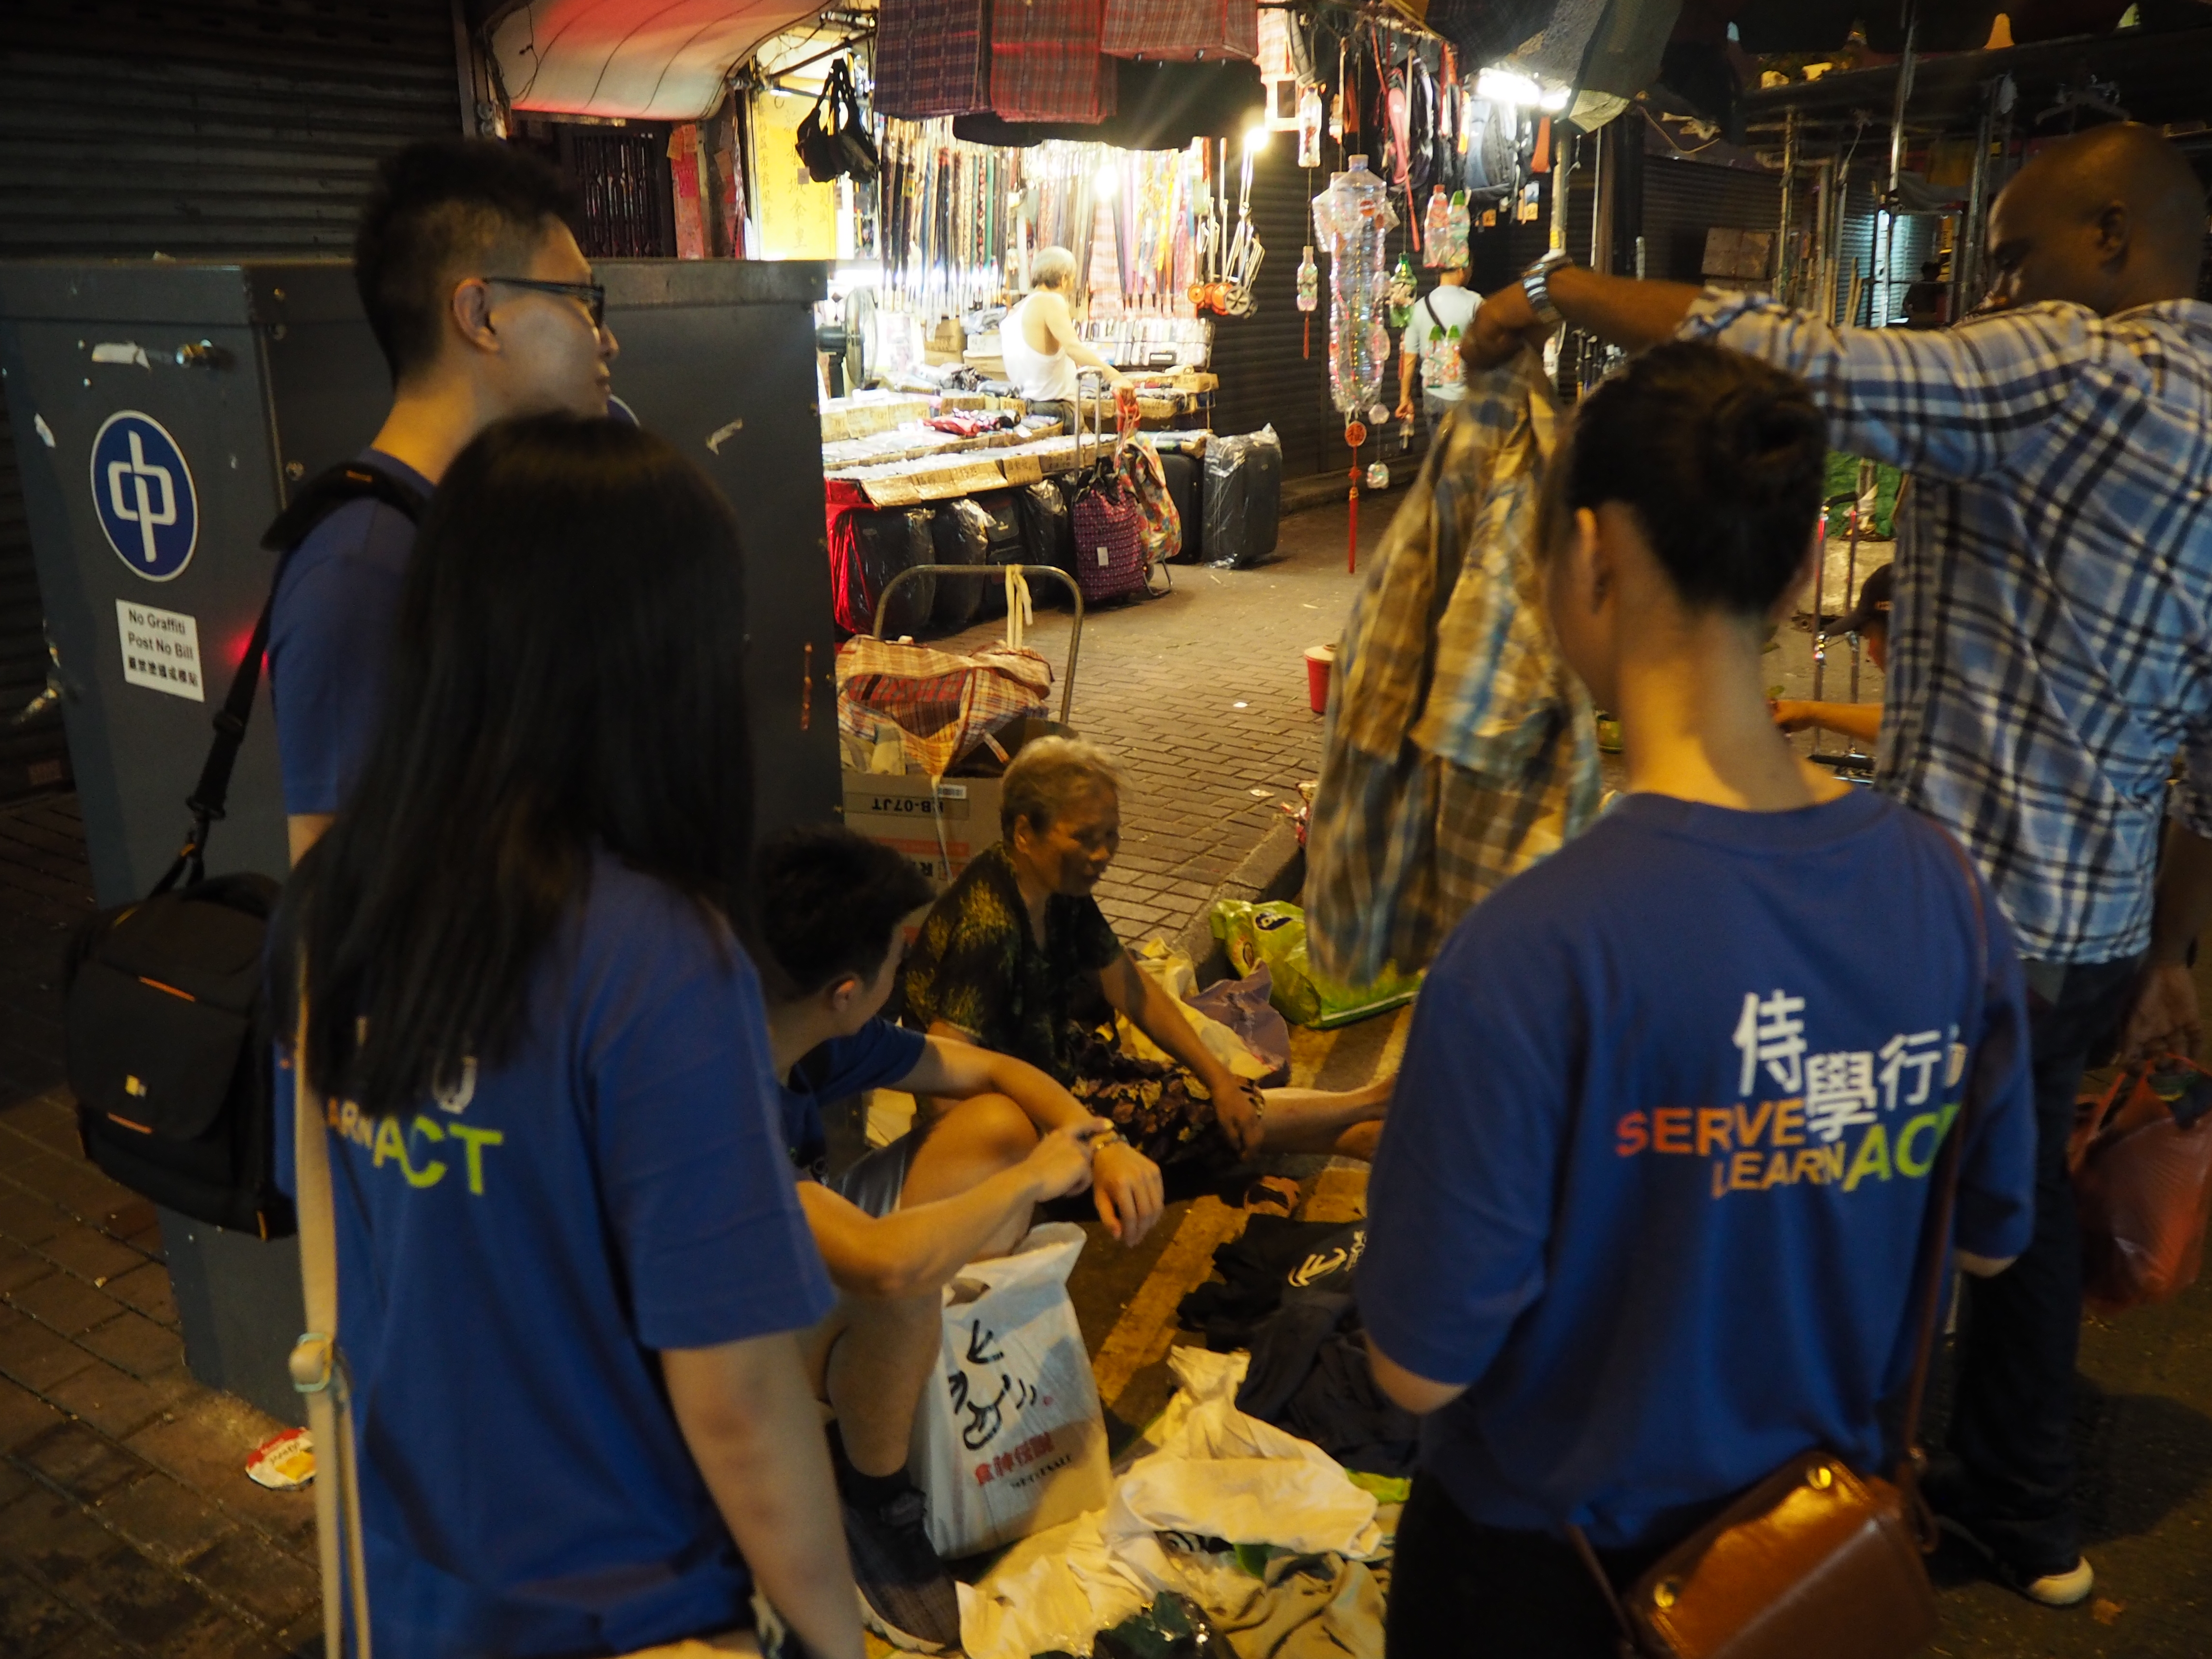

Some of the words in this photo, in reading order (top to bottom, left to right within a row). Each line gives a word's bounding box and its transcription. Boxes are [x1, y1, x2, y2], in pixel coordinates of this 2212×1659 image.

[128, 609, 144, 625] No
[147, 613, 186, 635] Graffiti
[128, 631, 153, 650] Post
[156, 637, 171, 654] No
[174, 642, 193, 660] Bill
[373, 1113, 504, 1196] ACT
[1615, 1096, 1806, 1158] SERVE
[1710, 1140, 1847, 1201] LEARN
